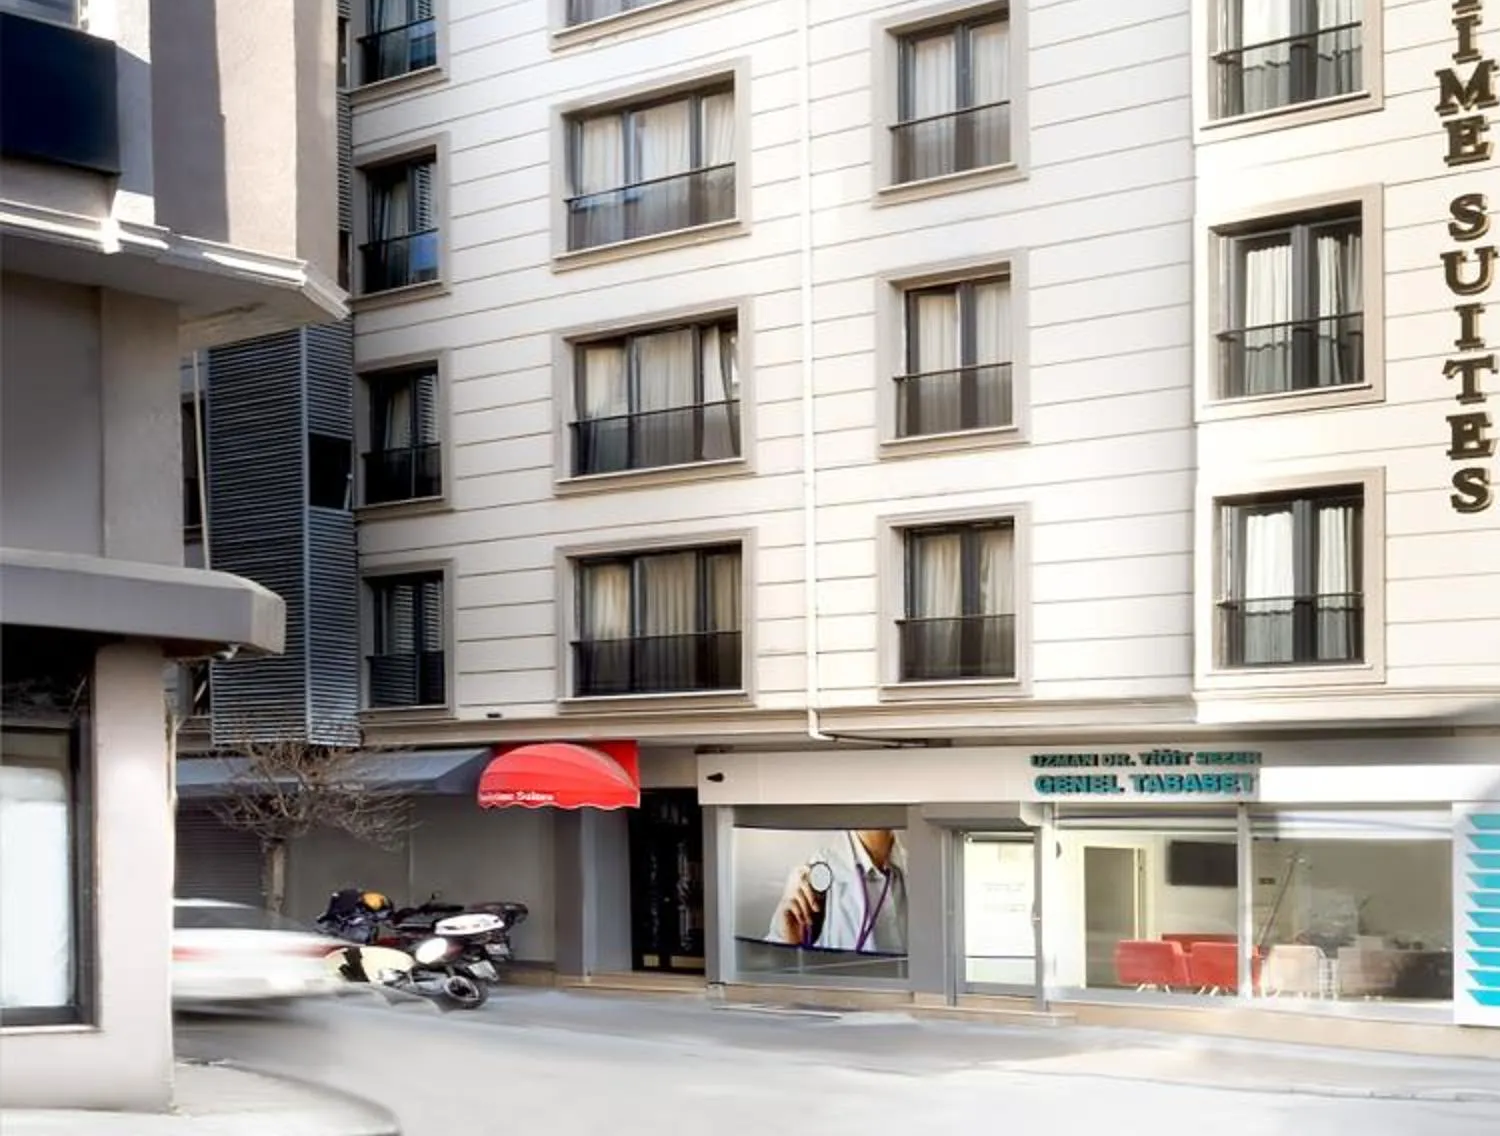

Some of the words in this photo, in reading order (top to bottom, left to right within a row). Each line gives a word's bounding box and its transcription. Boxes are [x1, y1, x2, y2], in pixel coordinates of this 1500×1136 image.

[1440, 193, 1499, 514] SUITES
[1034, 773, 1126, 795] GENEL
[1129, 772, 1257, 795] TABABET
